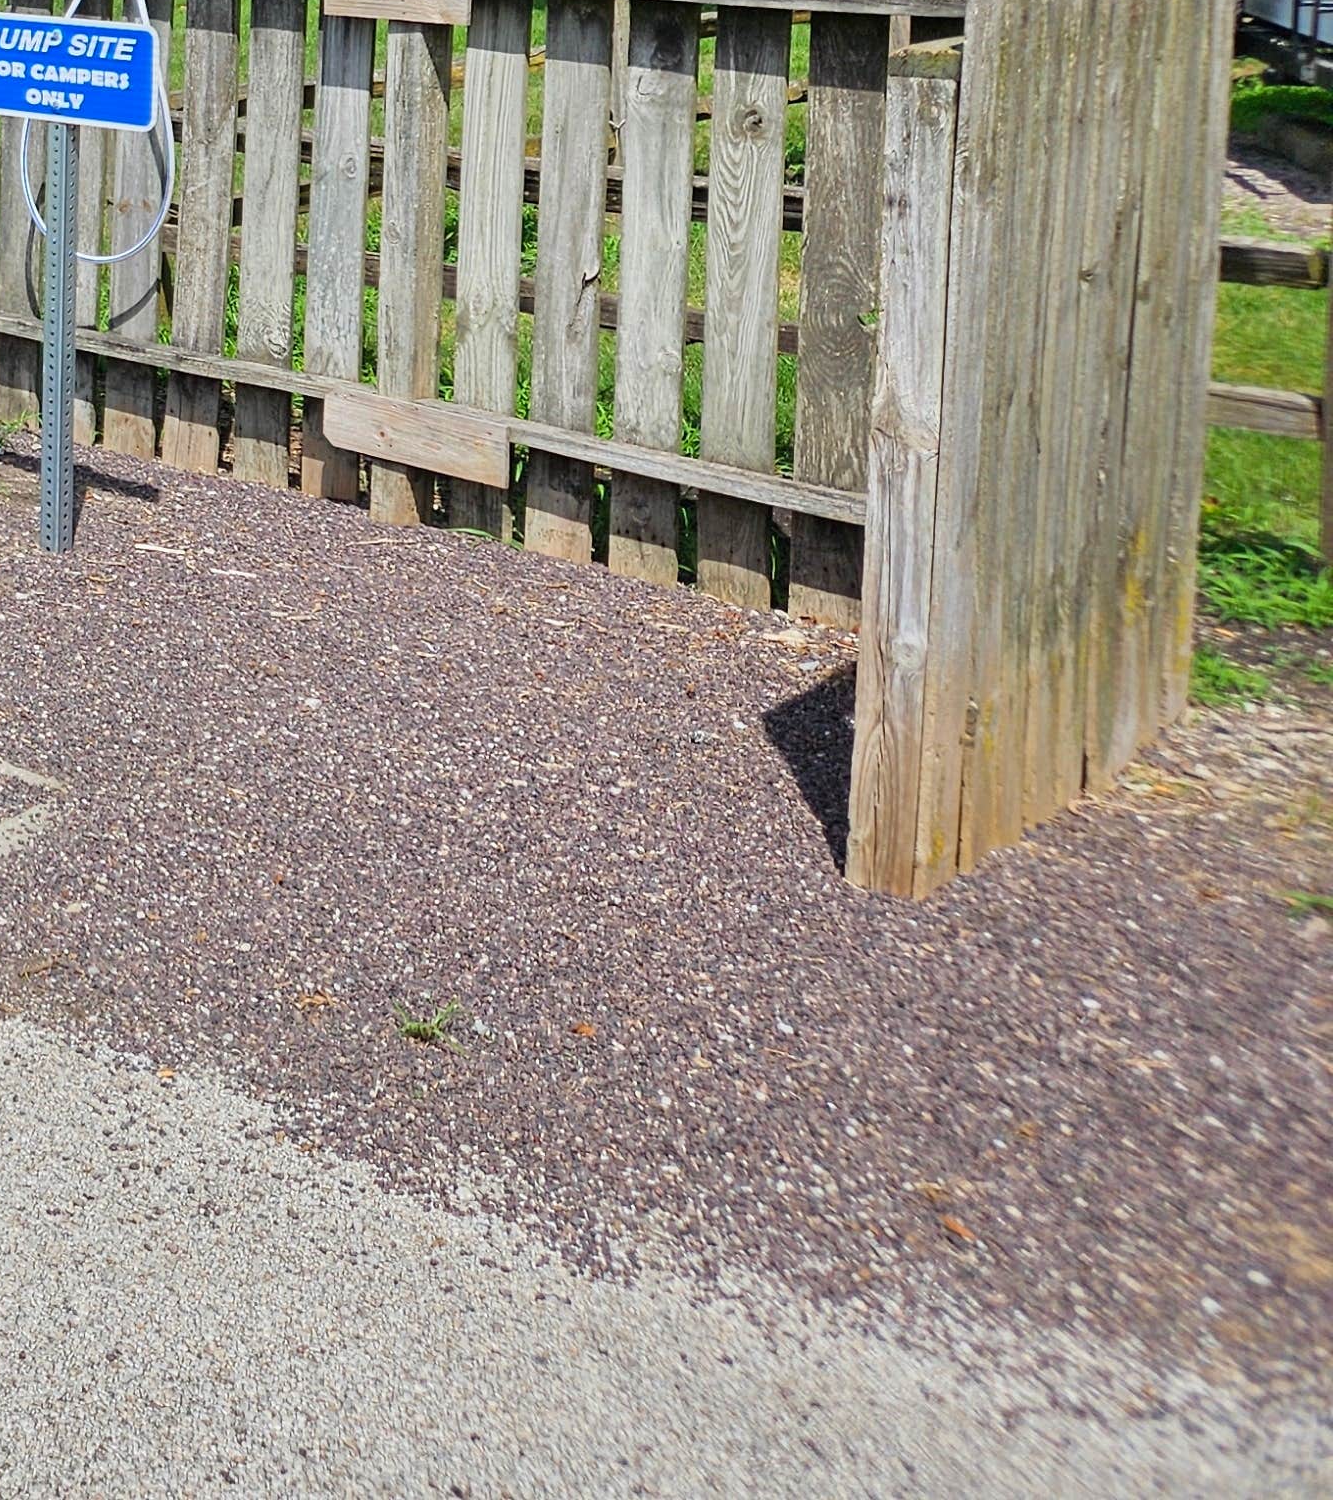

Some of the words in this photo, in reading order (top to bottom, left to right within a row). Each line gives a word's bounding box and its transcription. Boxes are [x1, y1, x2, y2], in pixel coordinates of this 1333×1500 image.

[67, 33, 137, 61] SITE
[30, 63, 130, 90] CAMPERS
[25, 88, 84, 110] ONLY
